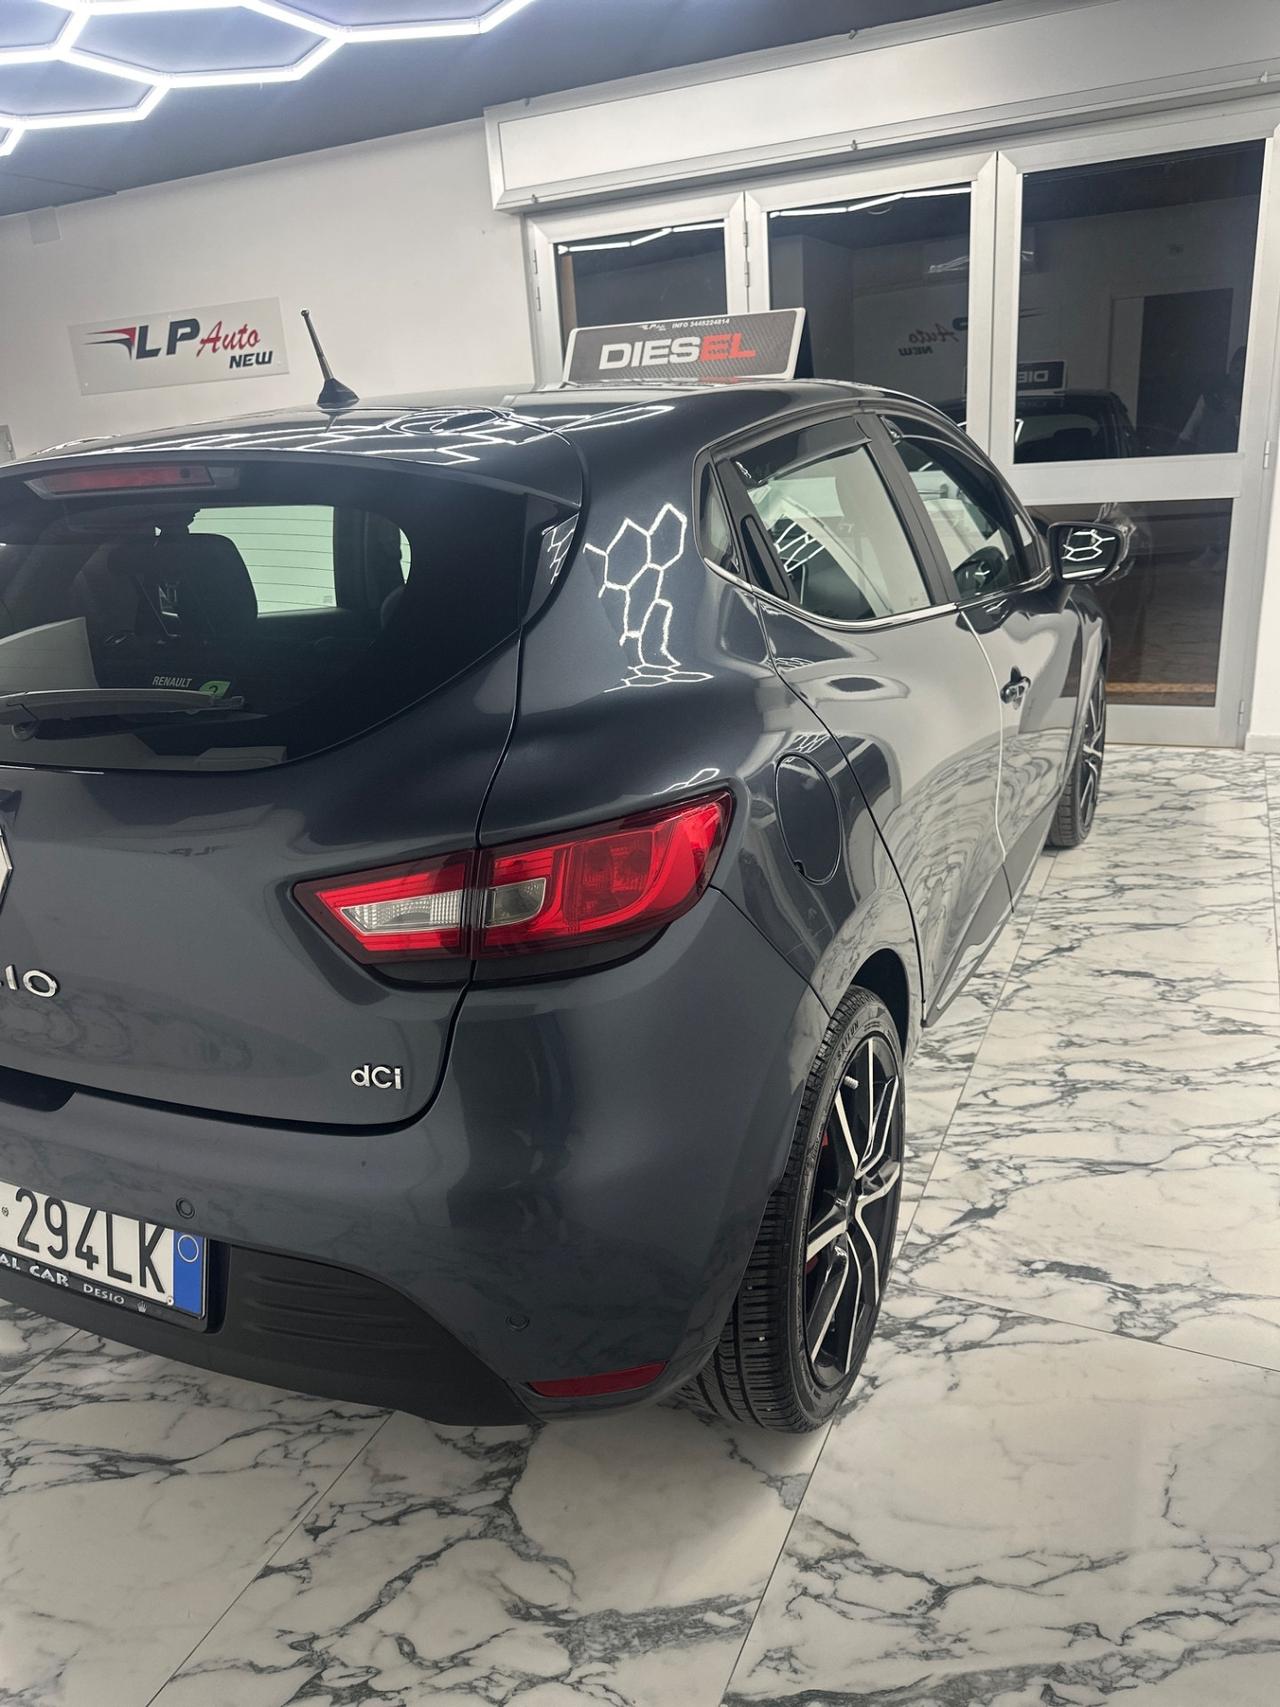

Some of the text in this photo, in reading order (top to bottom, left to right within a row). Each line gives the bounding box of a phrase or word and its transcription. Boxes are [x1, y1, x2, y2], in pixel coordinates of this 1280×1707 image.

[136, 318, 261, 360] LP Auto
[598, 332, 756, 370] DIESEL
[229, 351, 273, 369] NEW
[152, 675, 192, 688] RENAULT
[0, 965, 58, 998] IO
[350, 1064, 402, 1090] dCi
[15, 1187, 165, 1294] 294LK
[29, 1265, 70, 1287] CAR
[83, 1283, 125, 1305] DESIO
